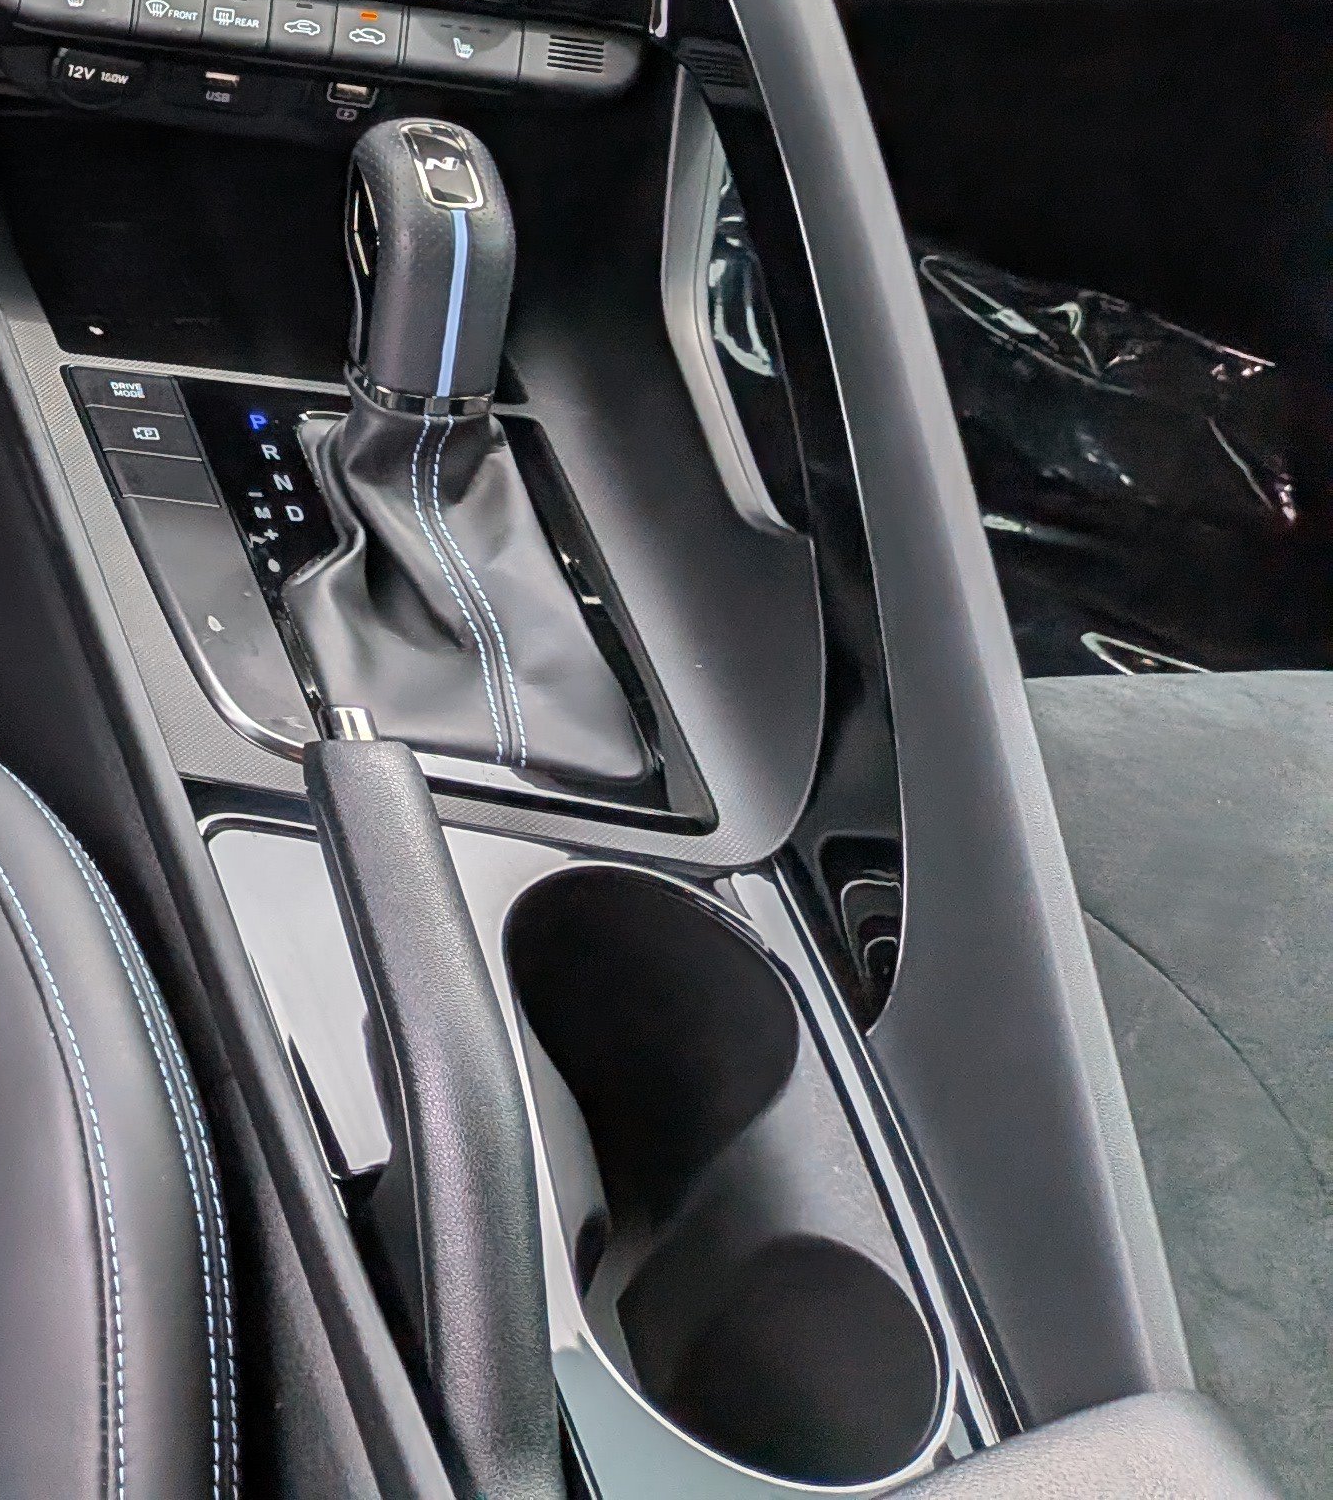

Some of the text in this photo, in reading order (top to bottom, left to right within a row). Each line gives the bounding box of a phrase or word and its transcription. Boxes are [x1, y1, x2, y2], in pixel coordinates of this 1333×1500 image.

[167, 8, 199, 23] FRONT
[234, 16, 260, 30] REAR
[66, 63, 95, 82] 12V
[205, 90, 231, 103] USB
[109, 380, 143, 392] DRIVE
[113, 388, 146, 399] MODE
[249, 413, 268, 430] P
[260, 443, 281, 462] R
[272, 473, 294, 492] N
[253, 506, 272, 520] M
[284, 504, 305, 523] D
